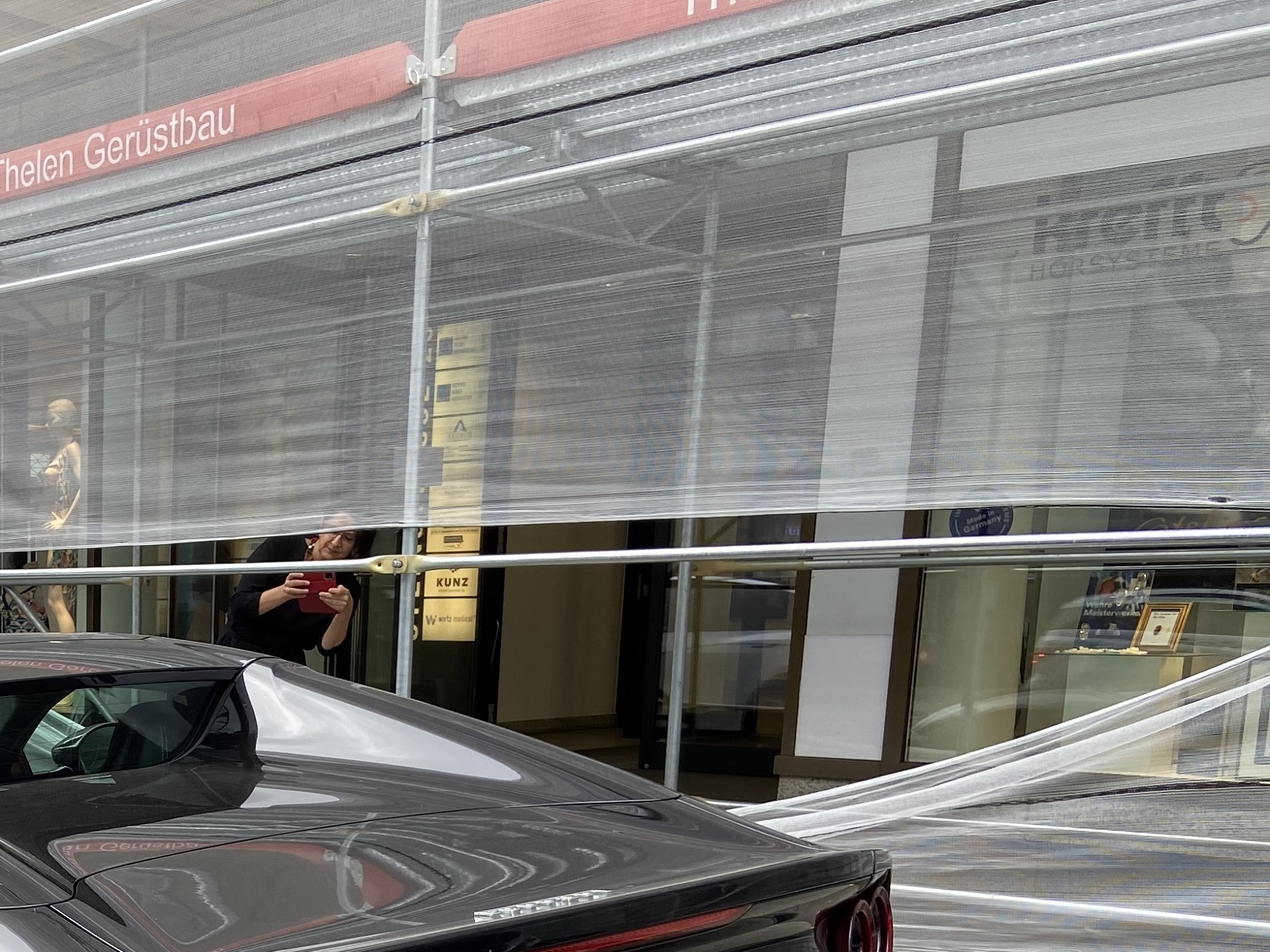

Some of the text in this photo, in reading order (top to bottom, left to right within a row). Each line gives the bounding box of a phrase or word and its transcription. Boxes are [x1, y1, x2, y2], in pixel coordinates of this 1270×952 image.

[84, 104, 236, 170] Gerüstbau
[963, 515, 1002, 534] Germany
[966, 513, 987, 525] Made
[436, 577, 469, 587] KUNZ
